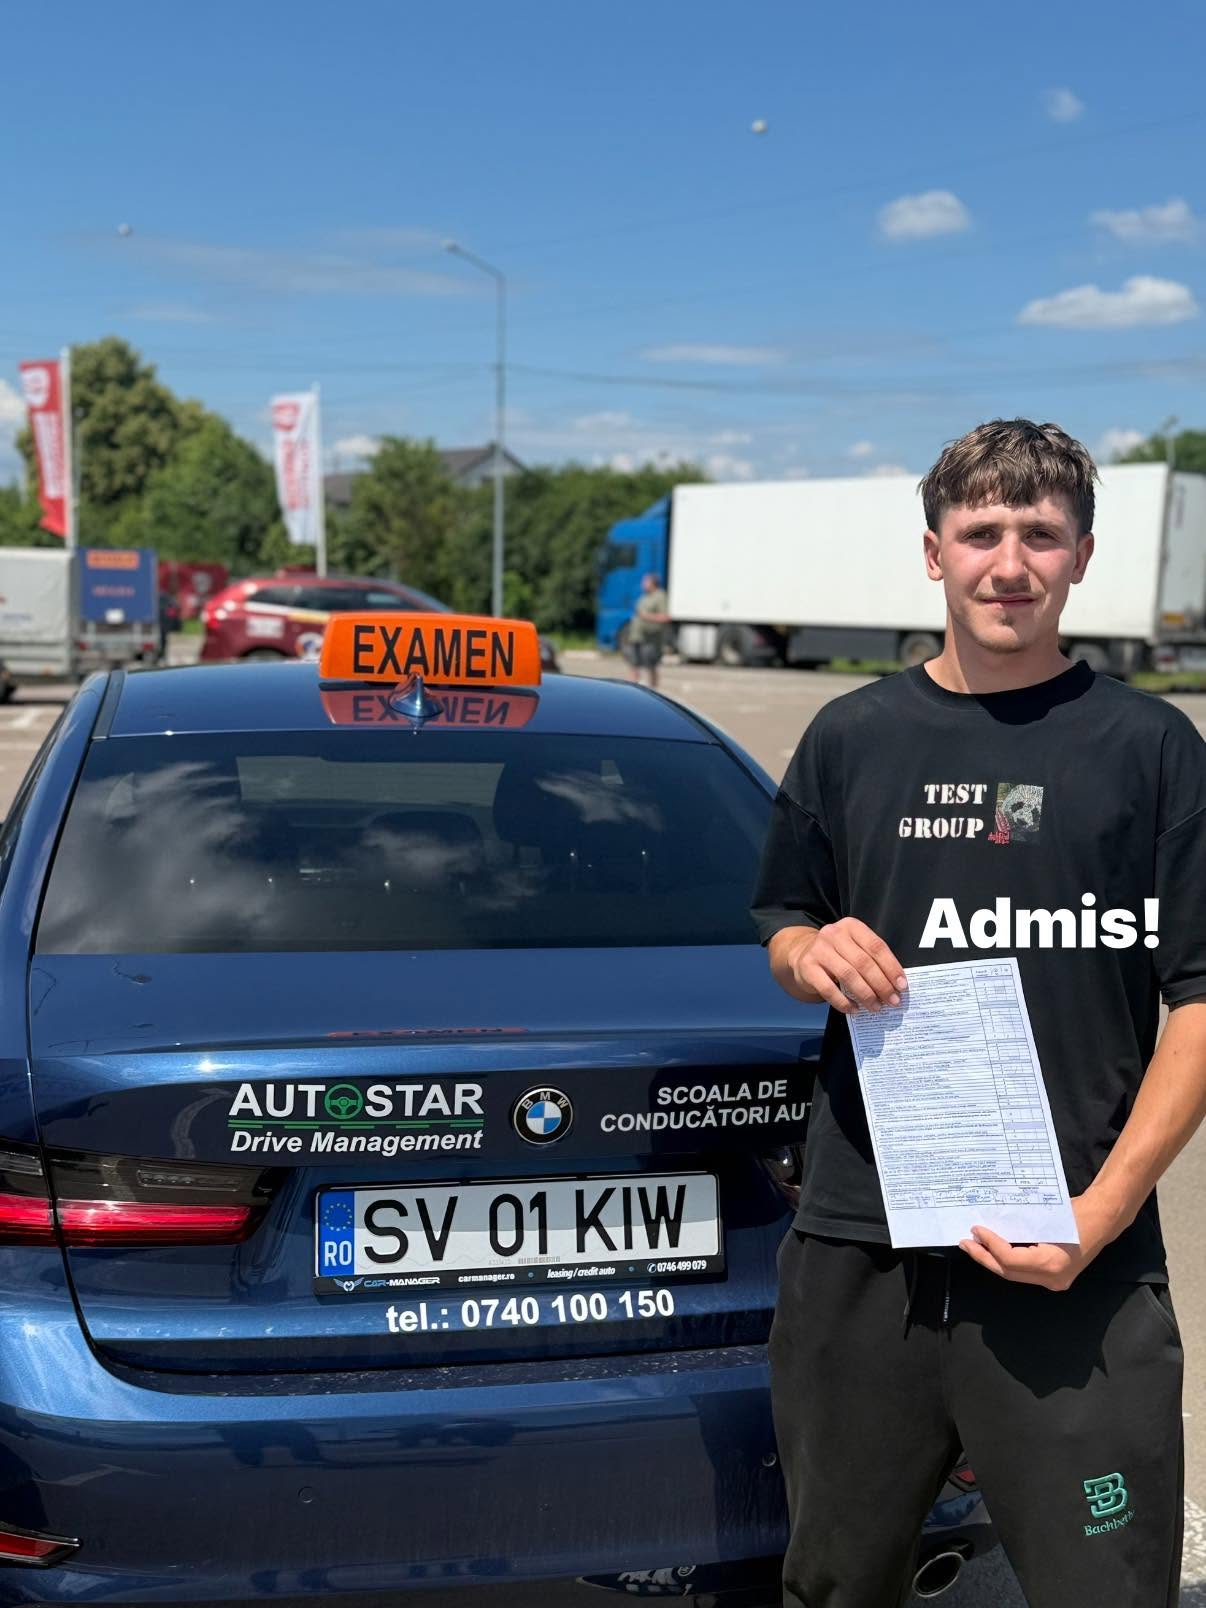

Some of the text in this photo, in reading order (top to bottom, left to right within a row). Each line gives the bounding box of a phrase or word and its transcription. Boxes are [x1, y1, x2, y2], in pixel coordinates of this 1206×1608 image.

[353, 625, 514, 678] EXAMEN
[924, 783, 988, 805] TEST
[898, 817, 984, 839] GROUP
[521, 1091, 568, 1111] BMW
[657, 1079, 788, 1105] SCOALA DE
[600, 1102, 770, 1133] CONDUCĂTORI
[230, 1129, 484, 1157] Drive Management
[363, 1184, 687, 1264] SV 01 KIW
[323, 1240, 353, 1268] RO
[363, 1276, 441, 1288] CAR-MANAGER
[457, 1271, 516, 1283] carmanager.ro
[546, 1268, 573, 1279] leasing
[577, 1266, 599, 1277] credit
[598, 1266, 616, 1276] auto
[386, 1288, 675, 1334] tel.: 0740 100 150
